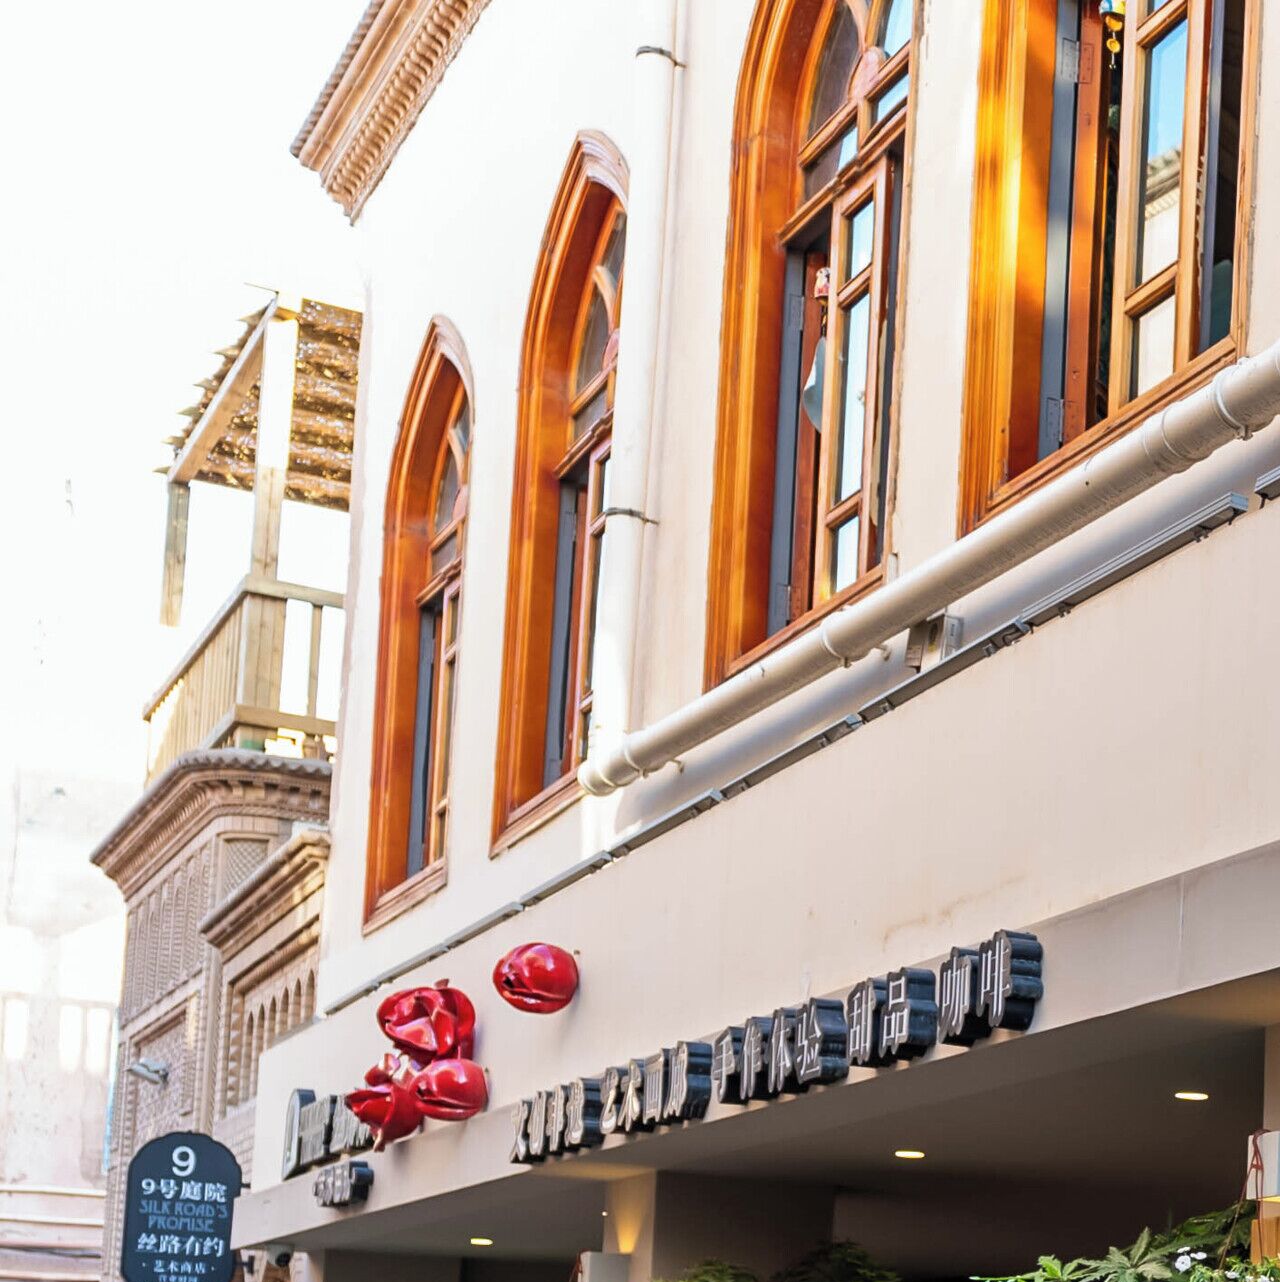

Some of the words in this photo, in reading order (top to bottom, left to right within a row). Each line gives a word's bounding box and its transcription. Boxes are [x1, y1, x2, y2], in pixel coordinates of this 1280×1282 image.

[714, 1003, 822, 1099] 手作体验
[849, 975, 908, 1057] 甜品
[941, 937, 1011, 1027] 咖啡
[171, 1145, 197, 1177] 9
[140, 1178, 228, 1203] 9号庭院
[139, 1200, 171, 1216] SILK
[174, 1203, 229, 1219] ROAD'S
[147, 1215, 215, 1233] PROMISE
[136, 1232, 225, 1257] 丝路有约
